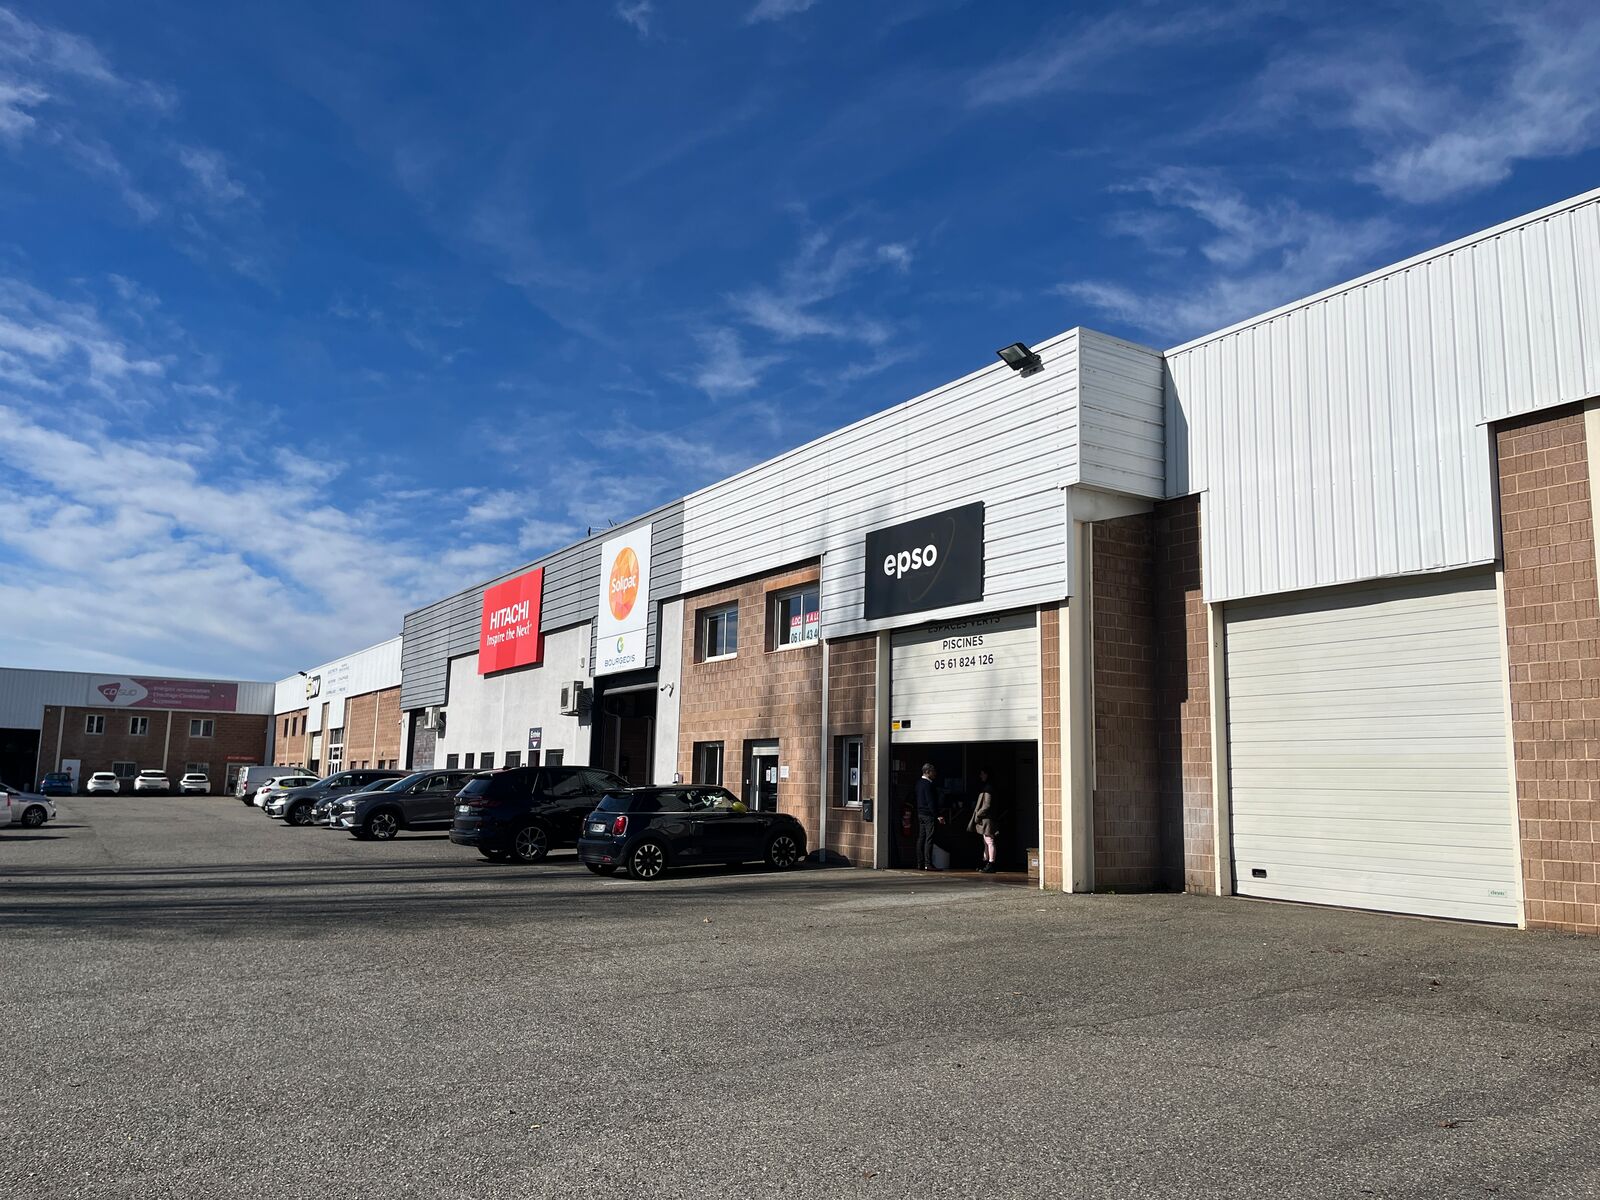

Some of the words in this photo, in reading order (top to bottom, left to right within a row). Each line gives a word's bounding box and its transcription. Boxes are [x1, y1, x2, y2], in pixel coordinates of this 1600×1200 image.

[883, 544, 937, 579] epso
[611, 575, 637, 593] Solipac
[490, 600, 530, 630] HITACHI
[506, 627, 516, 641] the
[516, 620, 530, 638] Next
[942, 635, 984, 650] PISCINES
[604, 654, 636, 668] BOURGEOIS
[934, 660, 946, 670] 05
[947, 658, 957, 668] 61
[959, 656, 976, 668] 824
[979, 654, 994, 665] 126
